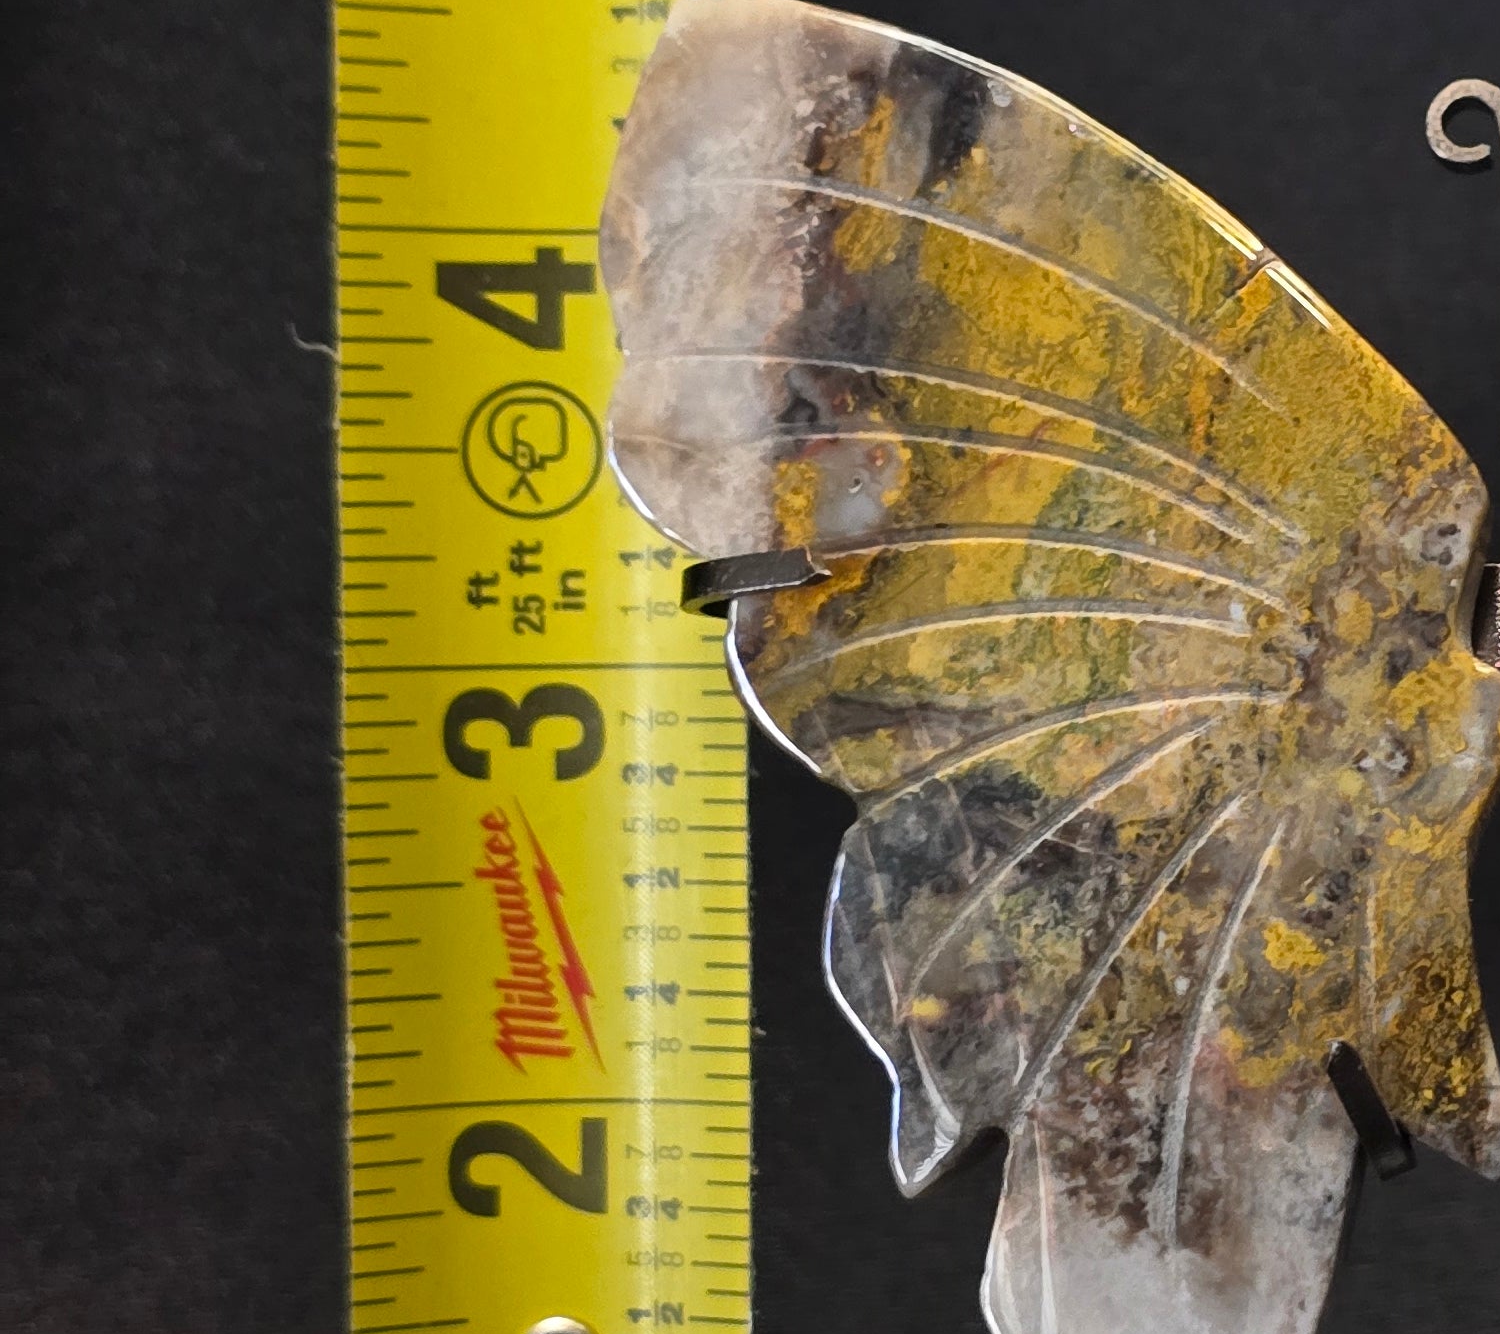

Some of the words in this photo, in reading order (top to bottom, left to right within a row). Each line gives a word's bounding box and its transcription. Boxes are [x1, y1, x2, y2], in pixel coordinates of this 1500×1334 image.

[435, 246, 598, 353] 4
[467, 570, 501, 610] ft
[509, 538, 545, 579] ft
[553, 567, 588, 612] in
[512, 594, 548, 636] 25
[442, 681, 606, 782] 3
[473, 805, 576, 1075] Milwaukee
[447, 1116, 609, 1219] 2
